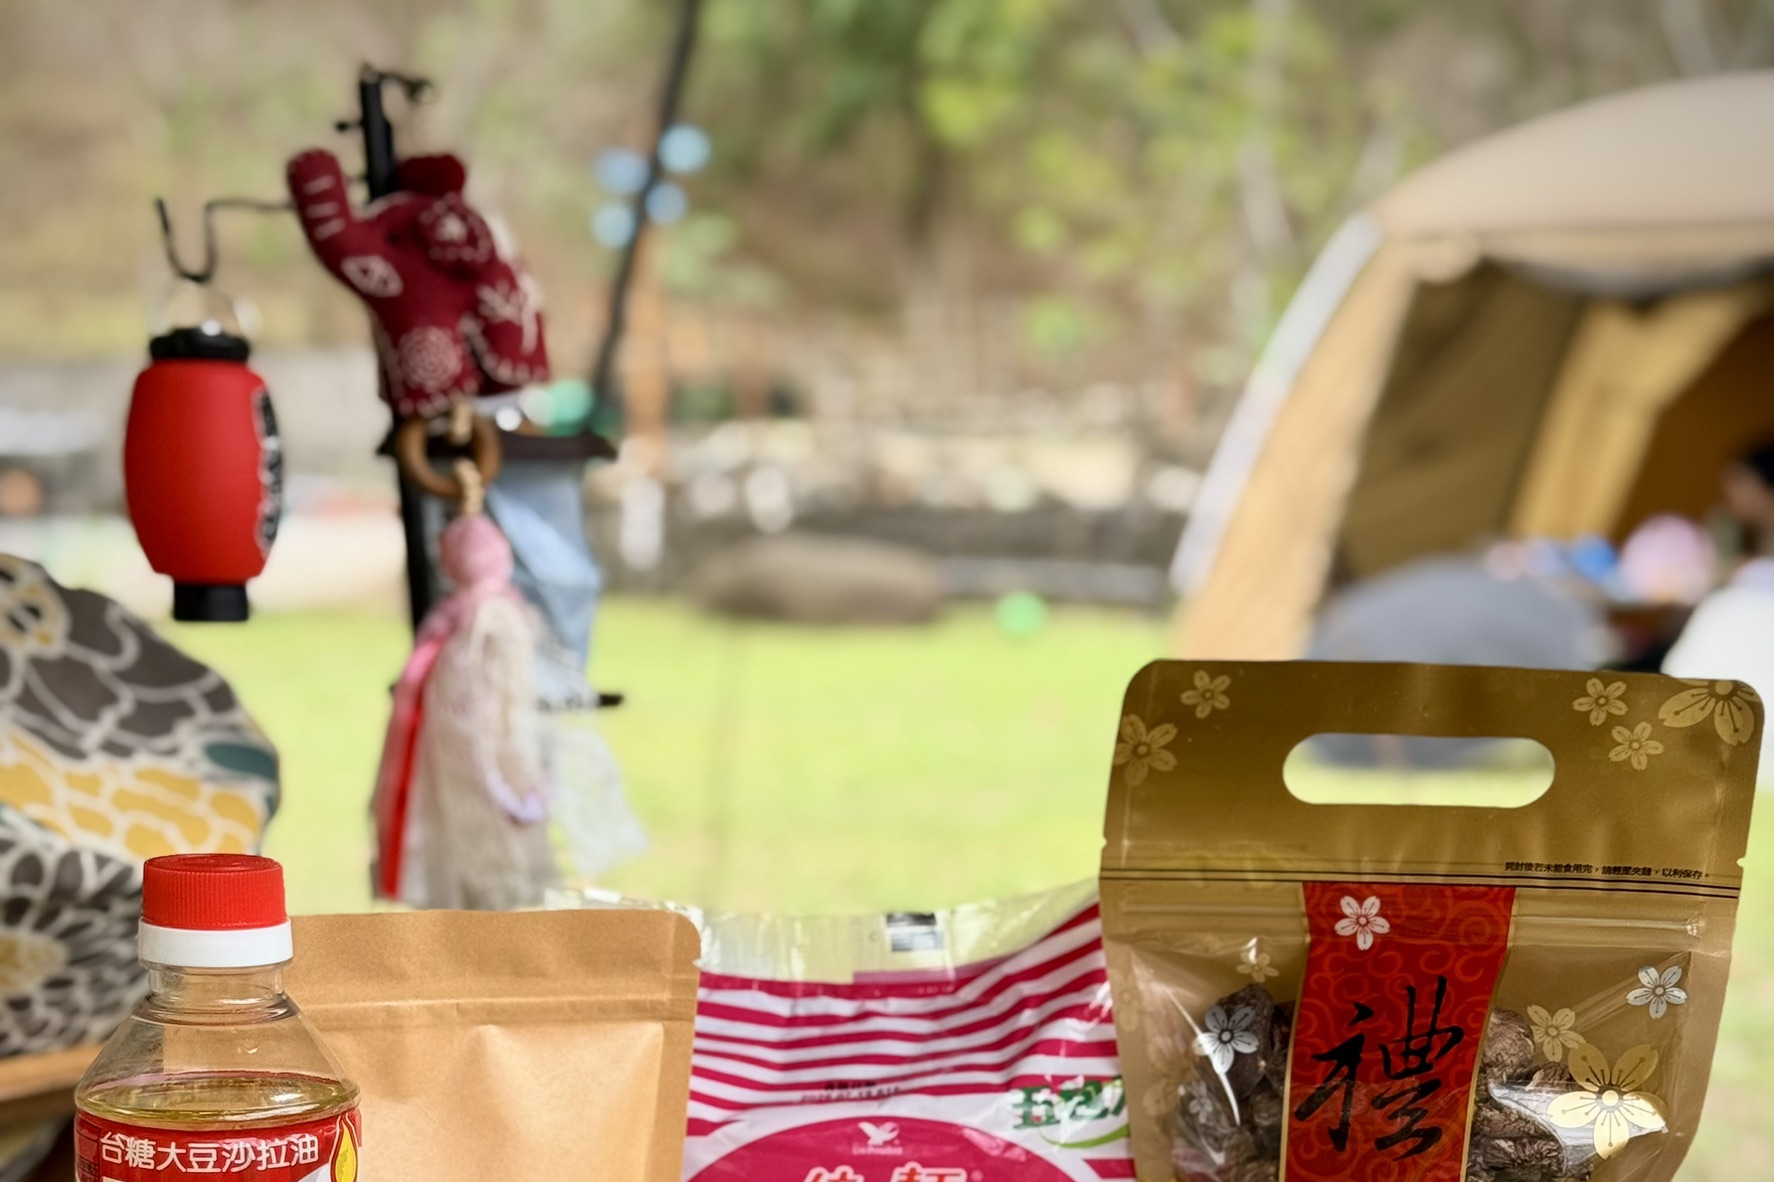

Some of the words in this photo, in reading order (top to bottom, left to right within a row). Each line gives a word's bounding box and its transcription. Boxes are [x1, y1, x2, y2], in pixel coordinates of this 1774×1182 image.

[1294, 975, 1465, 1161] 禮
[101, 1131, 319, 1173] 台糖大豆沙拉油
